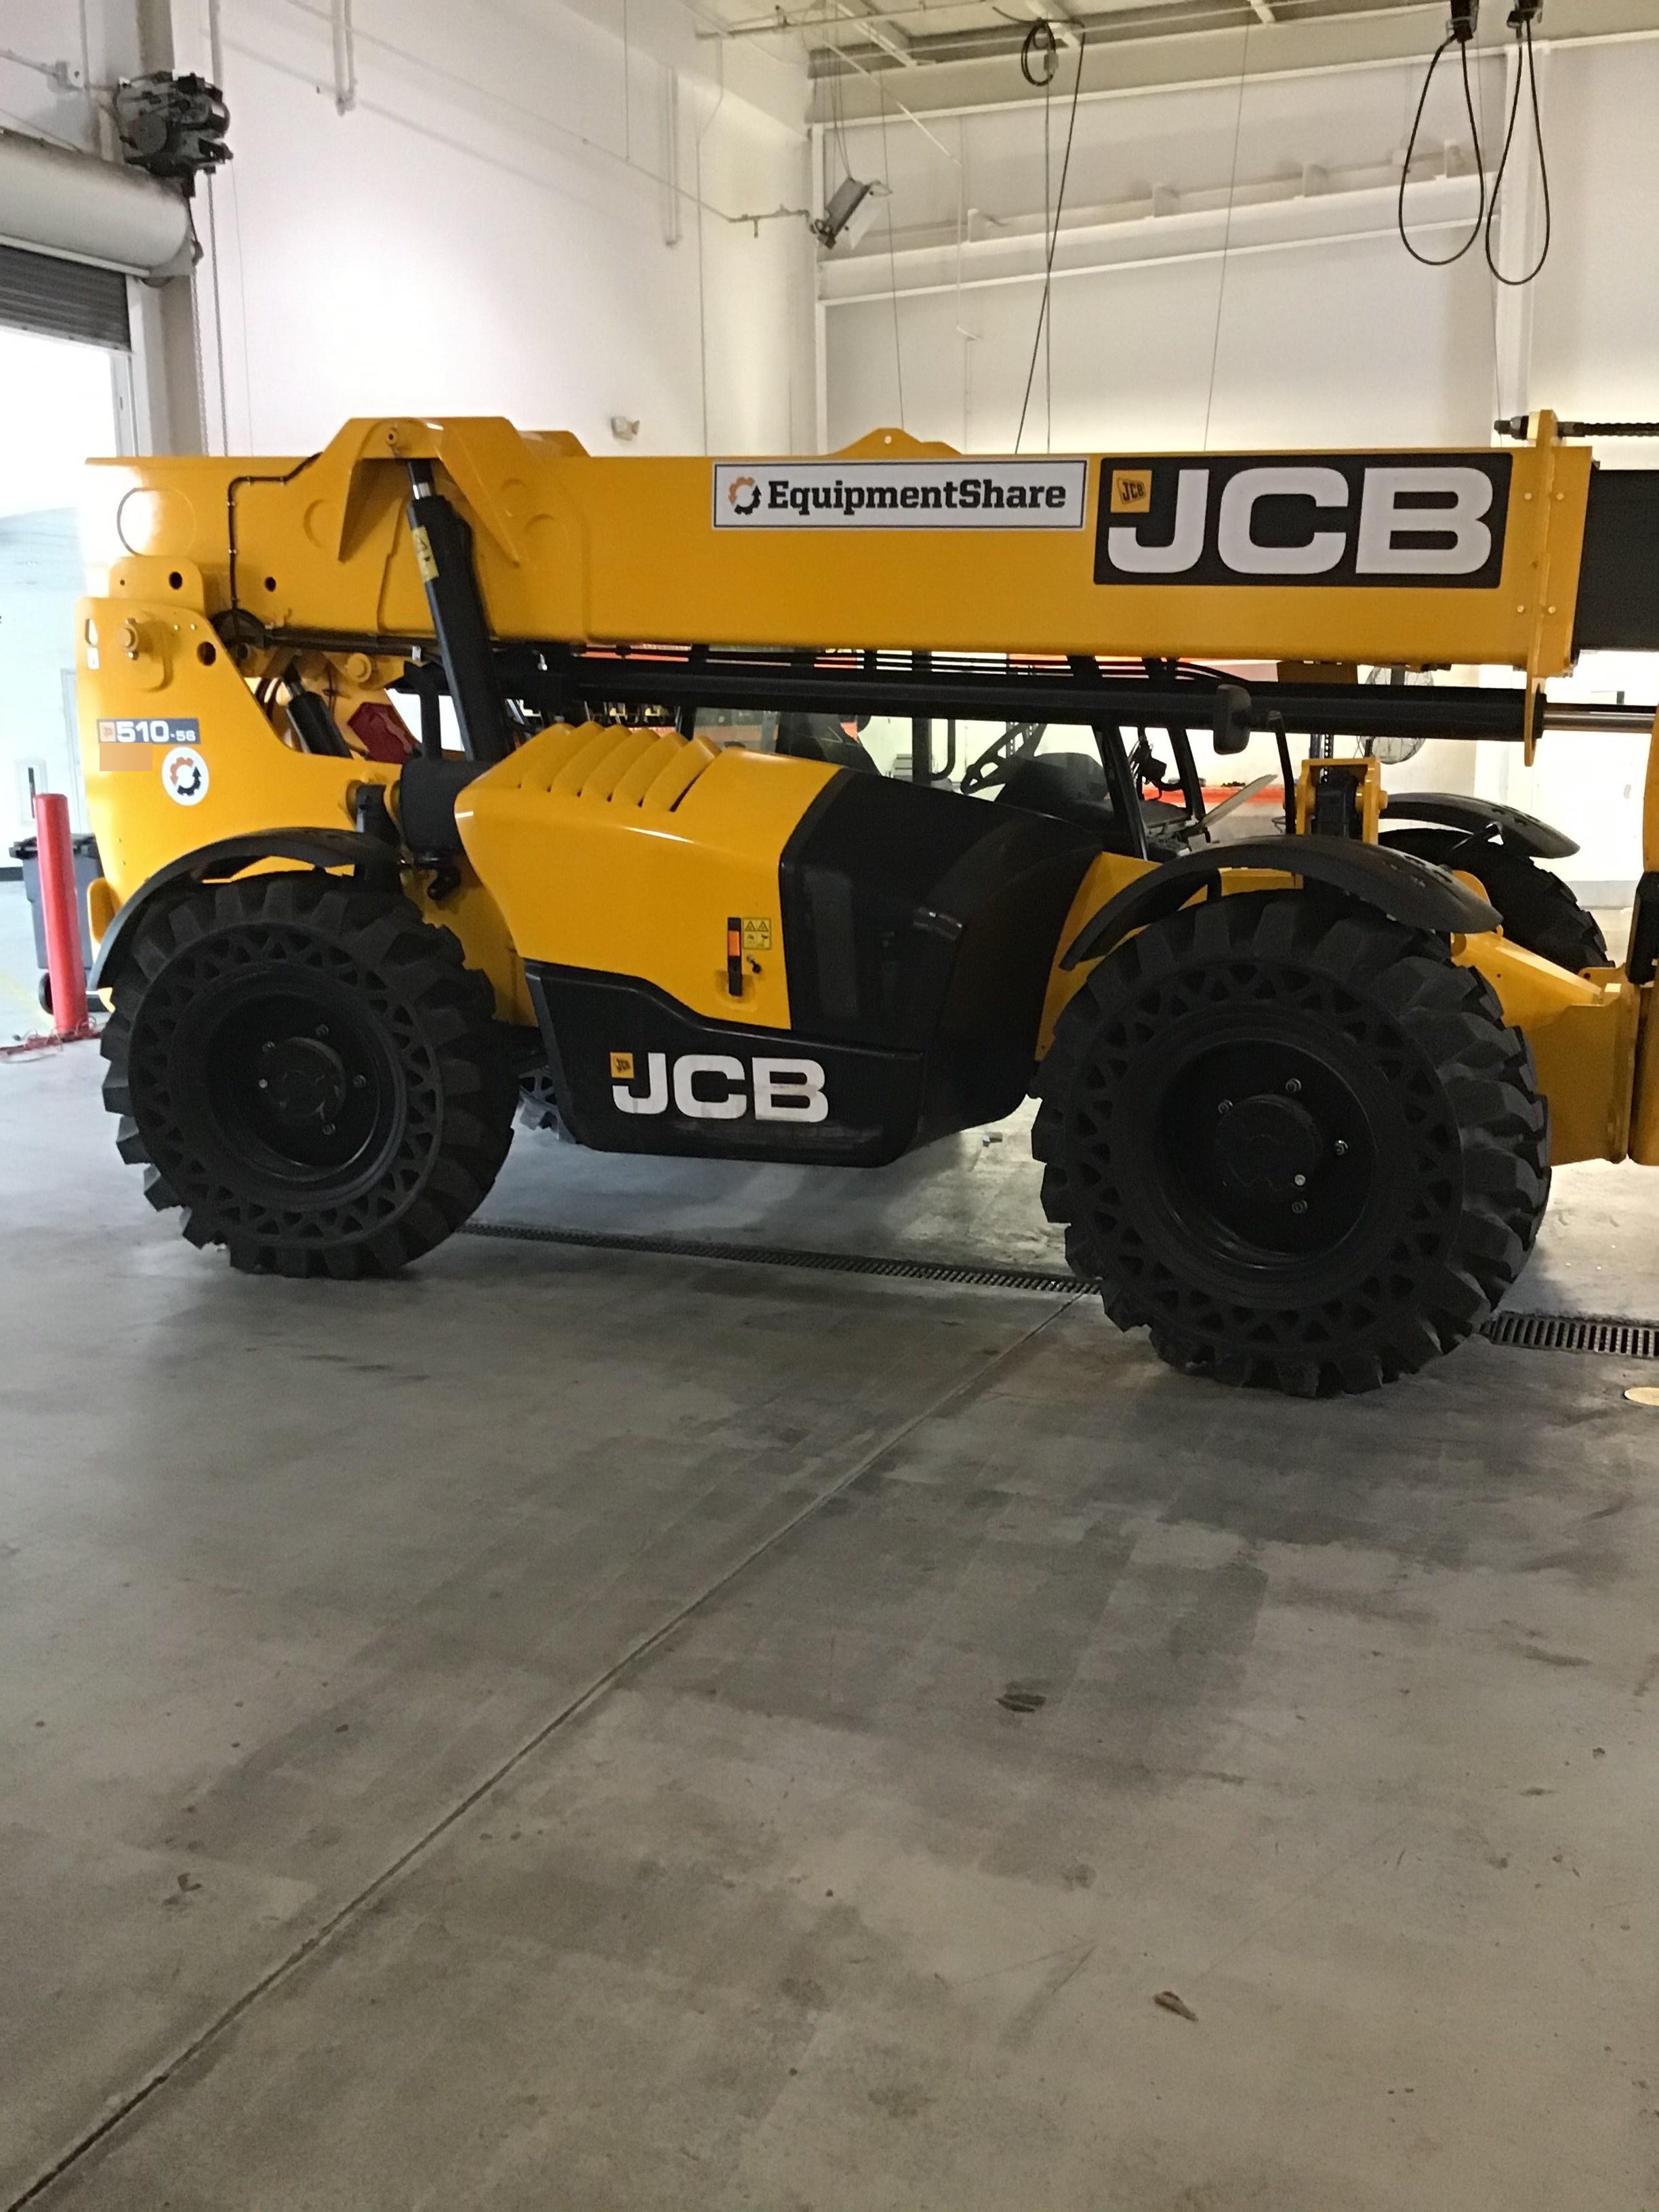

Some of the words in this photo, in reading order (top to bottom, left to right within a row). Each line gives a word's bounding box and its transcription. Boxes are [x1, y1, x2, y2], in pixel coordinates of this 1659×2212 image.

[768, 478, 1066, 516] EquipmentShare
[1122, 480, 1145, 501] JCB
[1108, 466, 1494, 575] JCB
[612, 1052, 829, 1123] JCB
